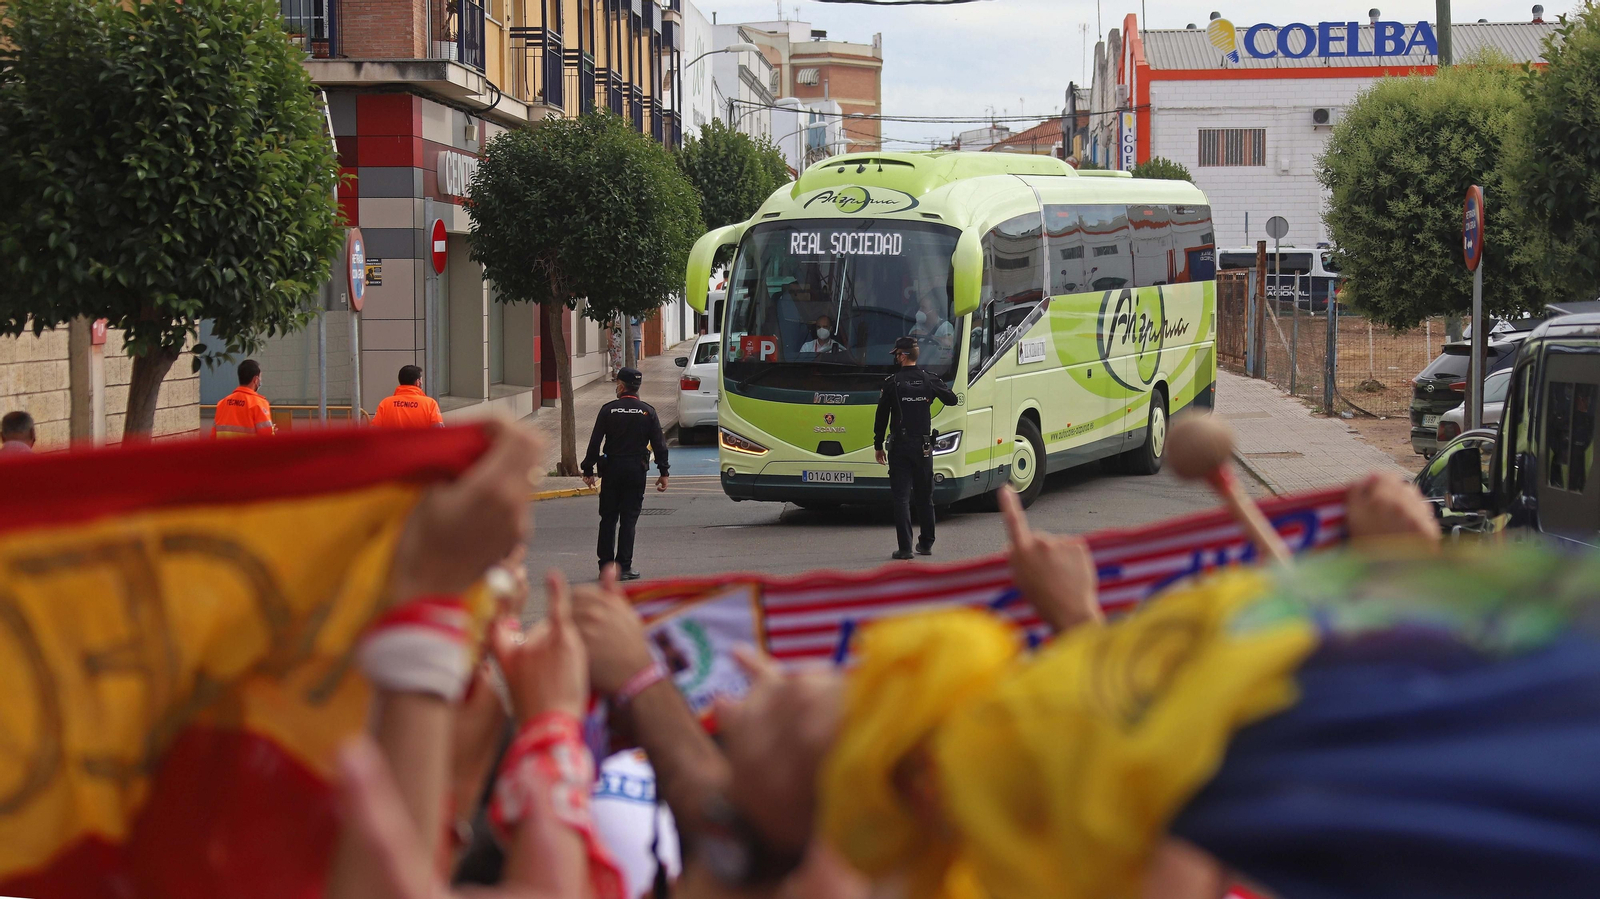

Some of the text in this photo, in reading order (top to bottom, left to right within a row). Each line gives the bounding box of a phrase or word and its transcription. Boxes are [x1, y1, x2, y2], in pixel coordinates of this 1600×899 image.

[1244, 21, 1438, 59] COELBA
[791, 232, 902, 256] REAL SOCIEDAD
[760, 341, 776, 361] P
[808, 471, 852, 482] 0140 KPH
